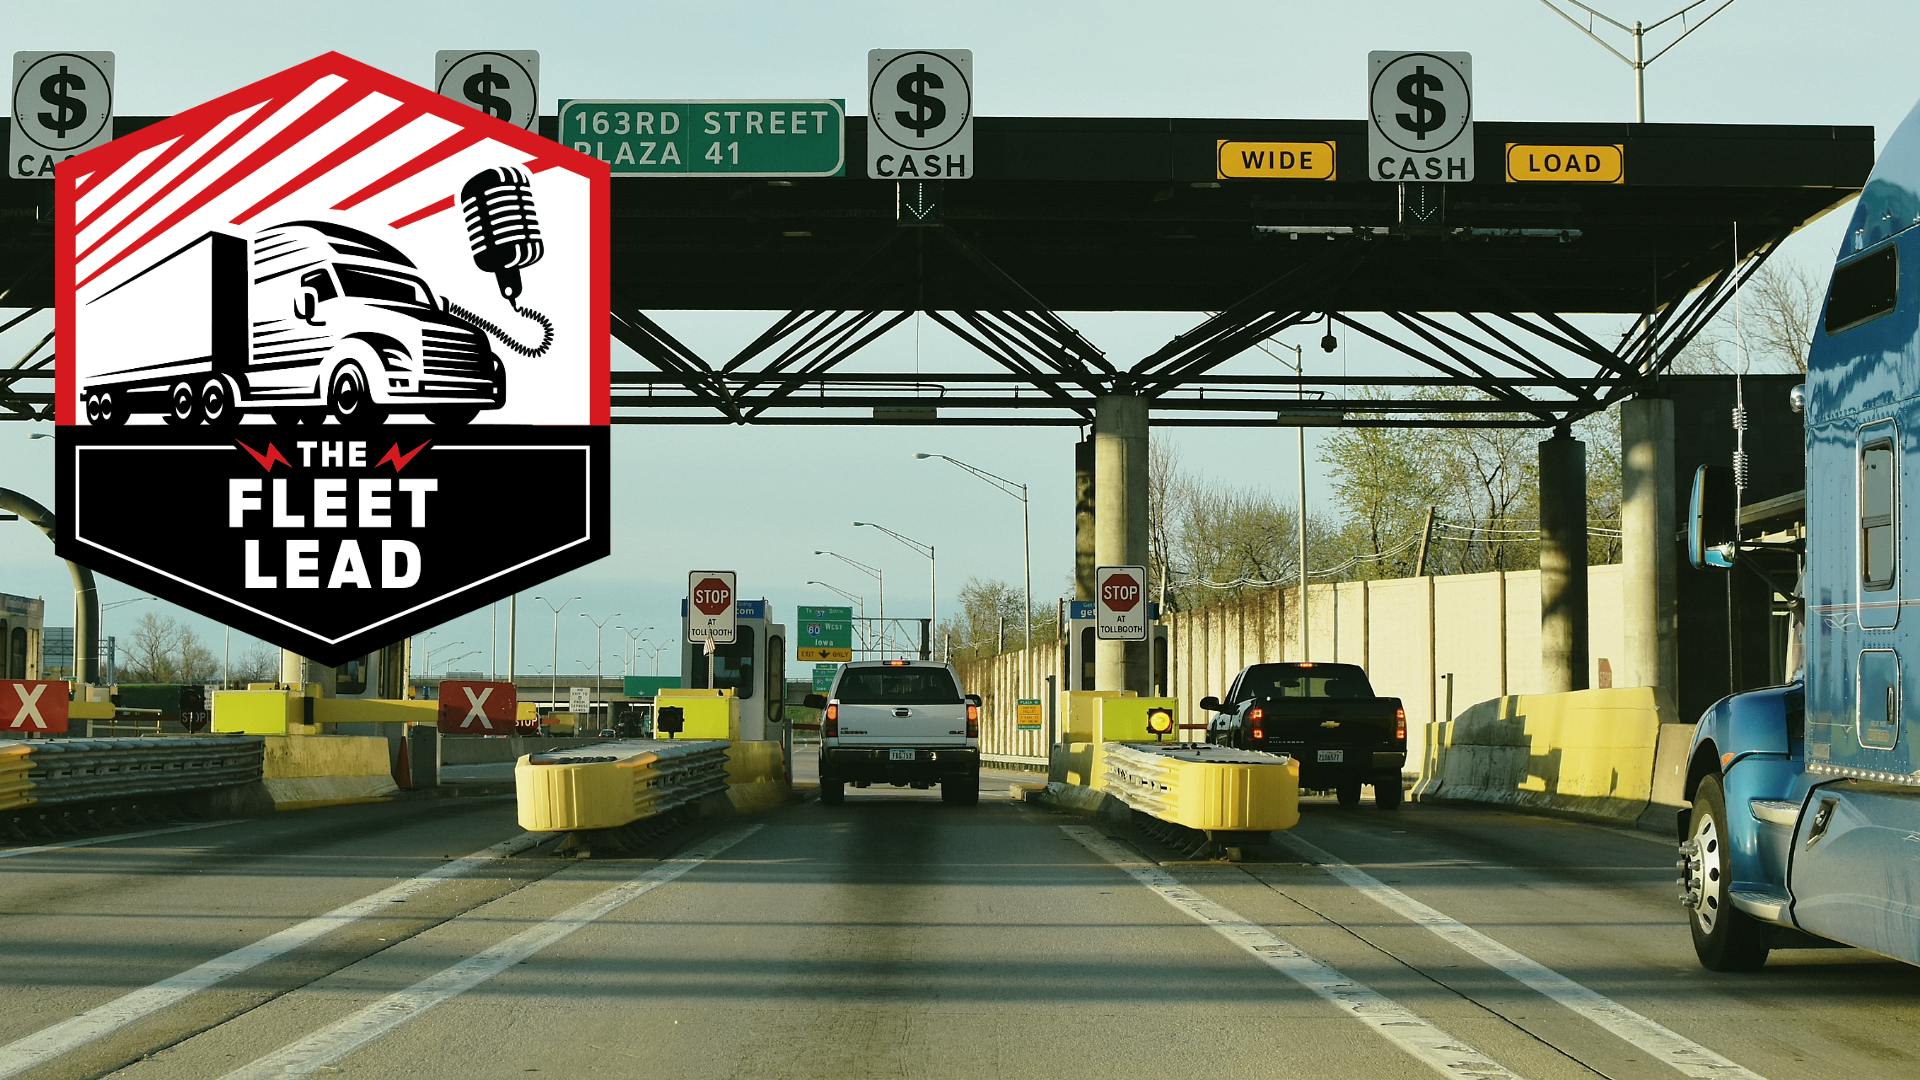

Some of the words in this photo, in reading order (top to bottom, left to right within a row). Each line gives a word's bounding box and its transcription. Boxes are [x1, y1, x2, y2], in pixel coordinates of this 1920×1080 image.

[575, 111, 681, 135] 163RD
[704, 111, 828, 134] STREET
[704, 142, 739, 165] 41
[1241, 151, 1313, 169] WIDE
[1529, 154, 1601, 172] LOAD
[876, 155, 965, 177] CASH
[1378, 157, 1466, 180] CASH
[696, 590, 729, 604] STOP
[1104, 586, 1138, 600] STOP
[808, 626, 820, 635] 80
[10, 684, 48, 728] X
[460, 686, 495, 729] X
